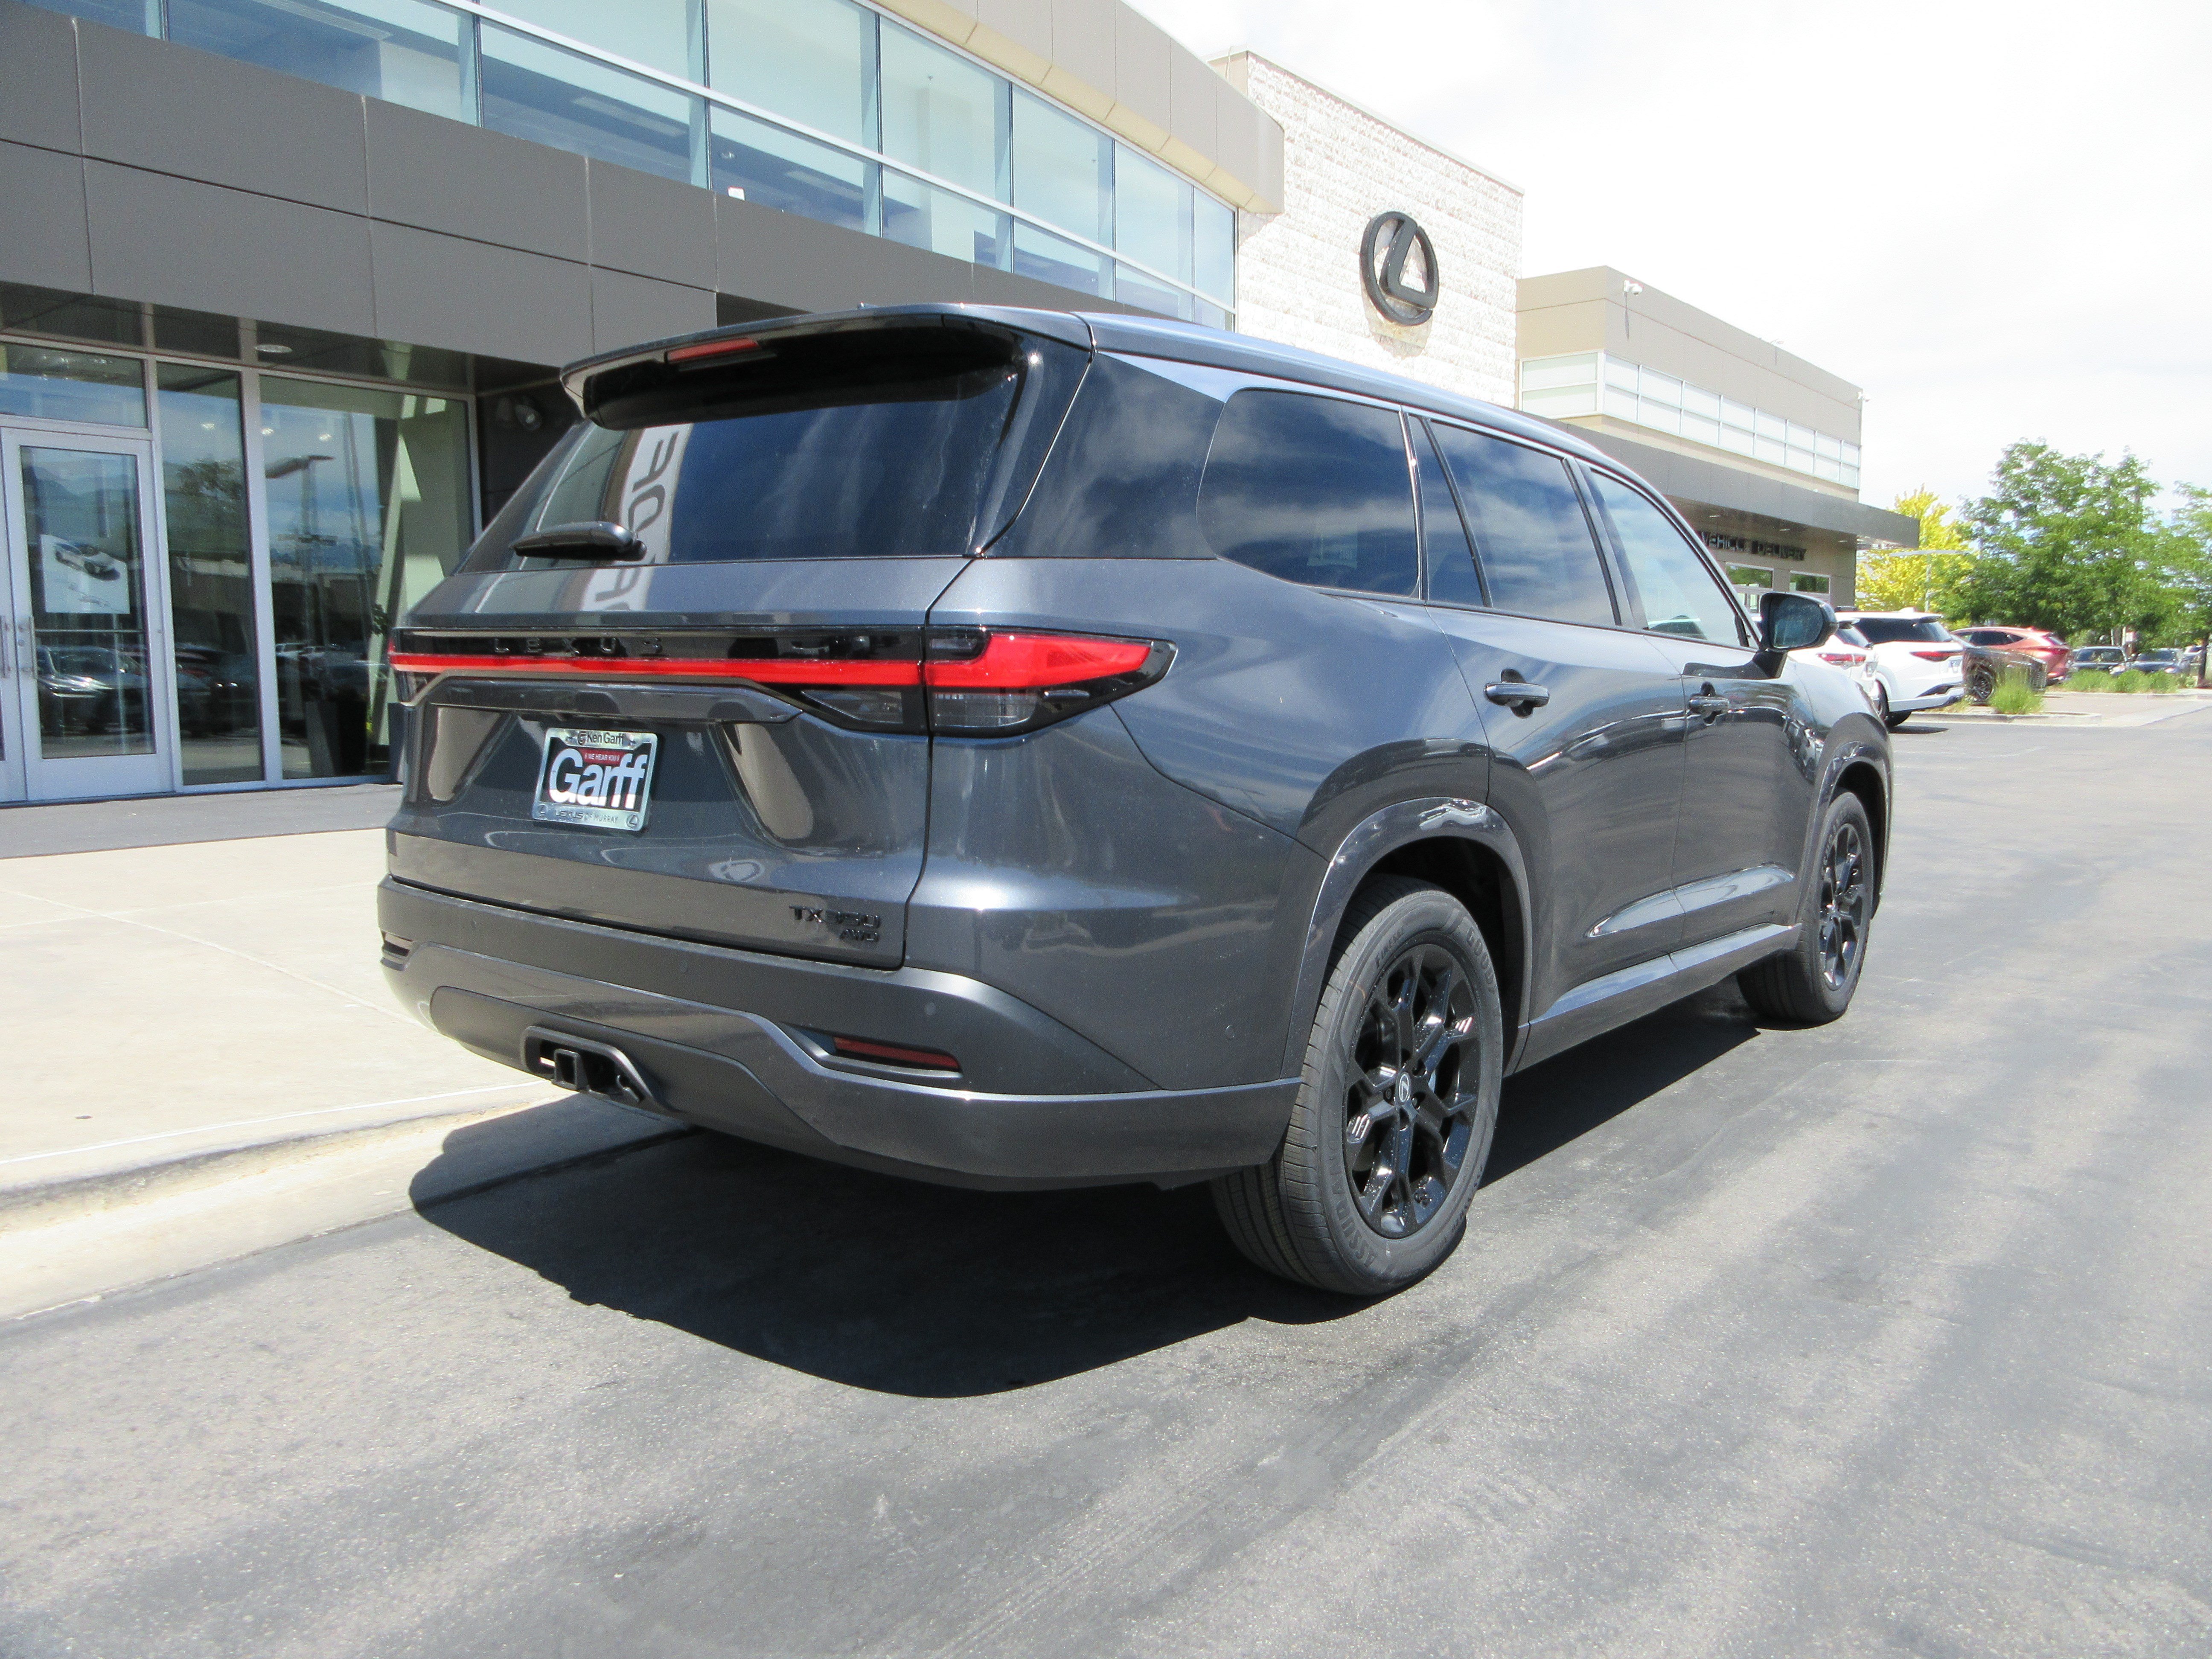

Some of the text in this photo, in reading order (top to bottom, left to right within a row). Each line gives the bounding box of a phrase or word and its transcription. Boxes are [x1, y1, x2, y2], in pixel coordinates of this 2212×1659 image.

[494, 637, 664, 655] LEXUS
[587, 731, 625, 746] Ken Garff
[549, 748, 648, 810] Garff
[556, 810, 583, 819] LEXUS
[789, 905, 824, 923] TX
[839, 928, 880, 941] AWD
